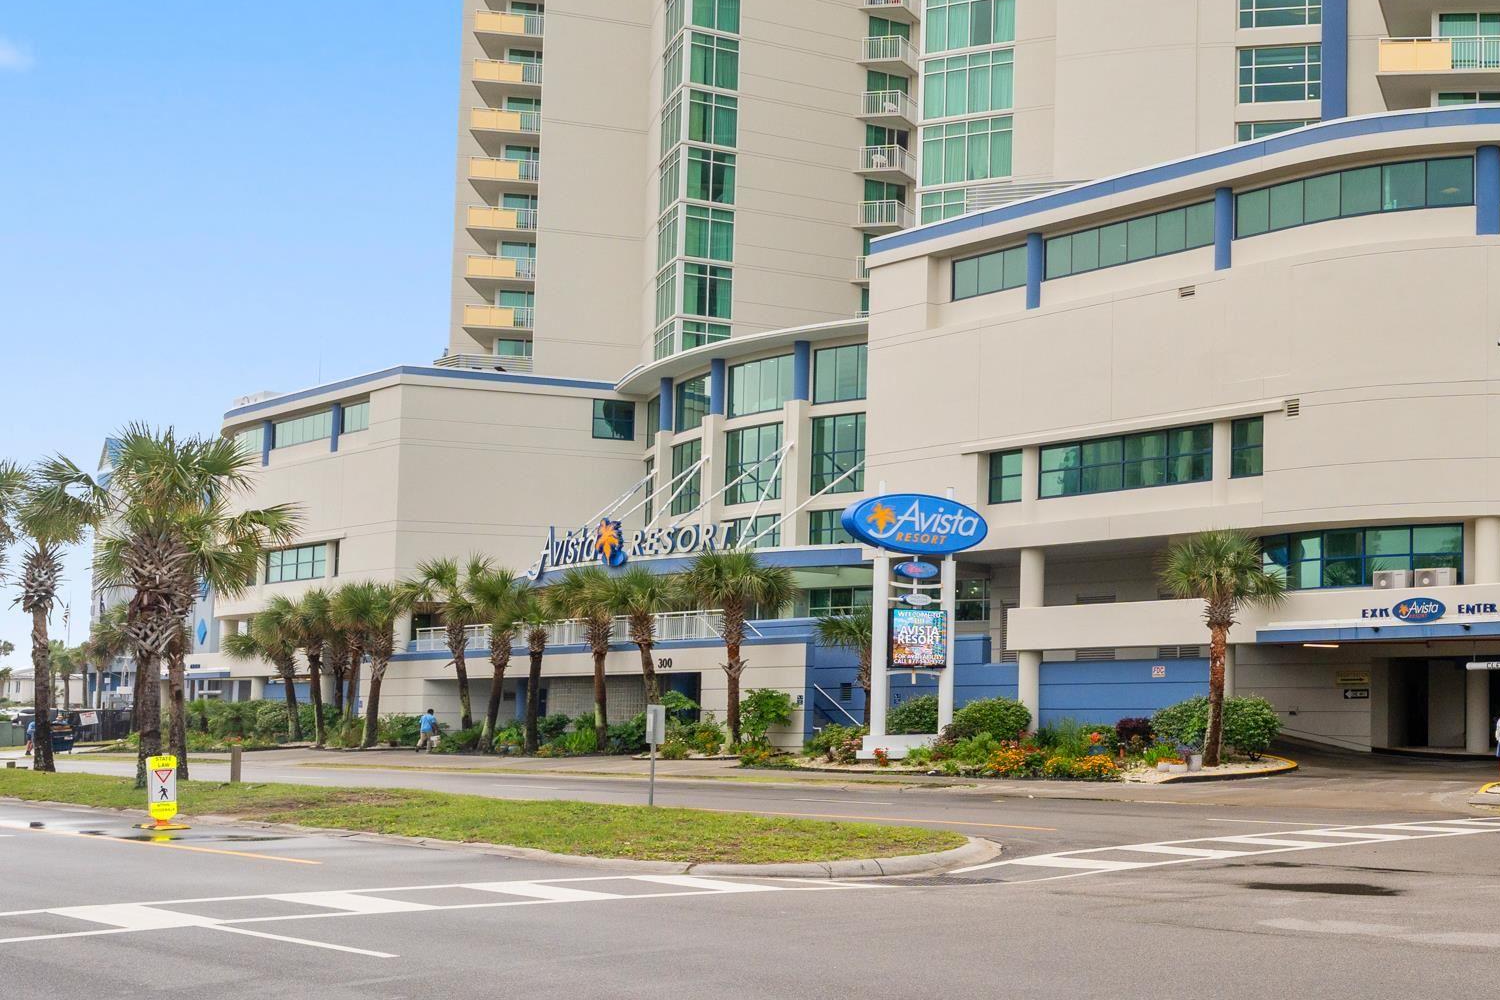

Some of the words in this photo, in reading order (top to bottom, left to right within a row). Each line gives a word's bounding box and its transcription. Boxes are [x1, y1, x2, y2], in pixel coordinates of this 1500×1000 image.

[867, 499, 979, 538] Avista
[896, 532, 947, 545] RESORT
[527, 525, 599, 580] Avista
[631, 521, 736, 556] RESORT
[1399, 601, 1439, 619] Avista
[1457, 603, 1498, 615] ENTER
[900, 626, 939, 635] AVISTA
[898, 635, 942, 645] RESORT
[657, 657, 673, 669] 300
